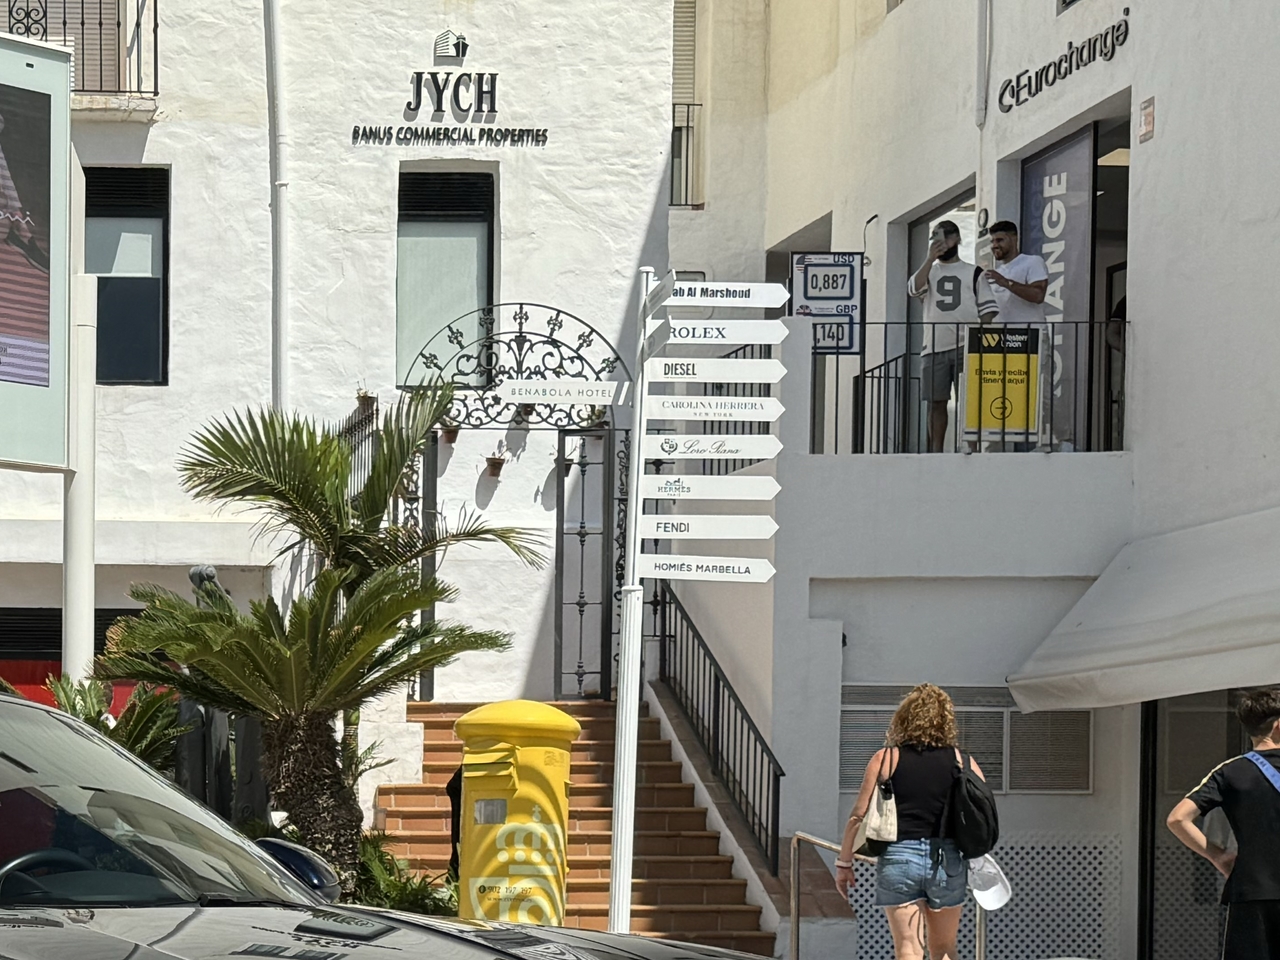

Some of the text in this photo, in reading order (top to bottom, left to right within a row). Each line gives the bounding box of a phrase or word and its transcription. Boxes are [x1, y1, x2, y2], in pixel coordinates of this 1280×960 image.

[1015, 18, 1130, 106] Eurochange
[405, 71, 499, 113] JYCH
[352, 125, 549, 147] BANUS COMMERCIAL PROPERTIES
[832, 254, 855, 264] USD
[810, 274, 847, 292] 0,887
[671, 287, 685, 298] ab
[700, 287, 751, 299] Marshoud
[935, 275, 962, 312] 9
[835, 304, 858, 314] GBP
[670, 326, 726, 339] ROLEX
[663, 363, 697, 376] DIESEL
[510, 388, 612, 398] BENABOLA HOTEL
[662, 400, 765, 411] CAROLINA HERRERA
[678, 439, 742, 455] Loro Piana
[655, 522, 690, 533] FENDI
[654, 562, 751, 575] HOMIÉS MARBELLA
